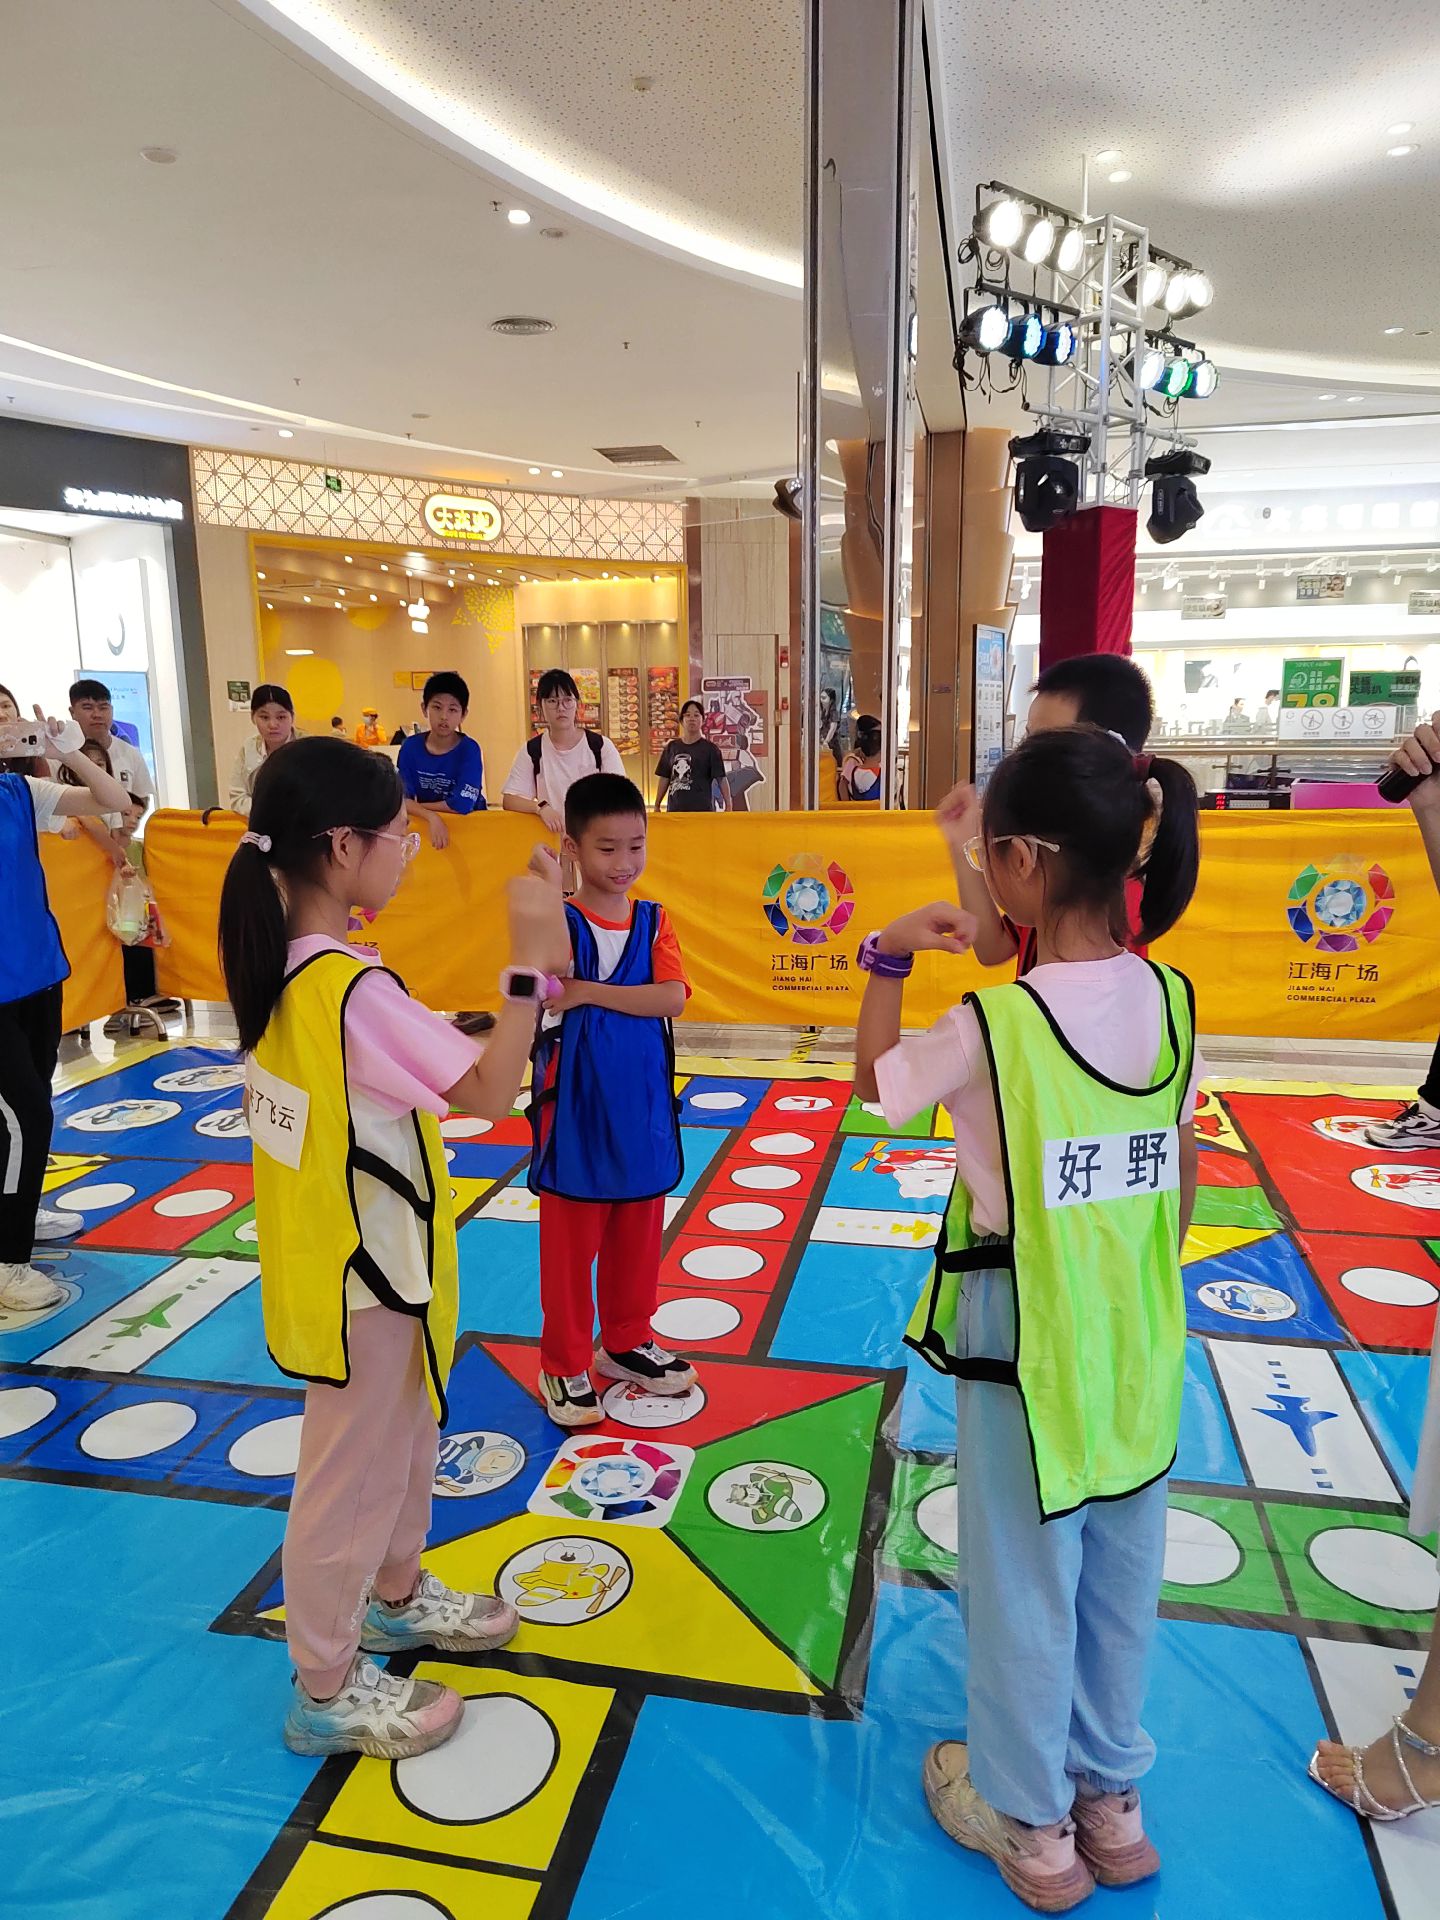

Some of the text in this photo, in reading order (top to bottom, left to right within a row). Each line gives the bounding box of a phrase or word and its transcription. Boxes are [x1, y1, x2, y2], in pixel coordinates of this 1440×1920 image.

[771, 954, 849, 971] 江海广场
[1288, 961, 1379, 982] 江海广场
[1287, 994, 1347, 1003] COMMERCIAL
[1058, 1132, 1167, 1200] 好野
